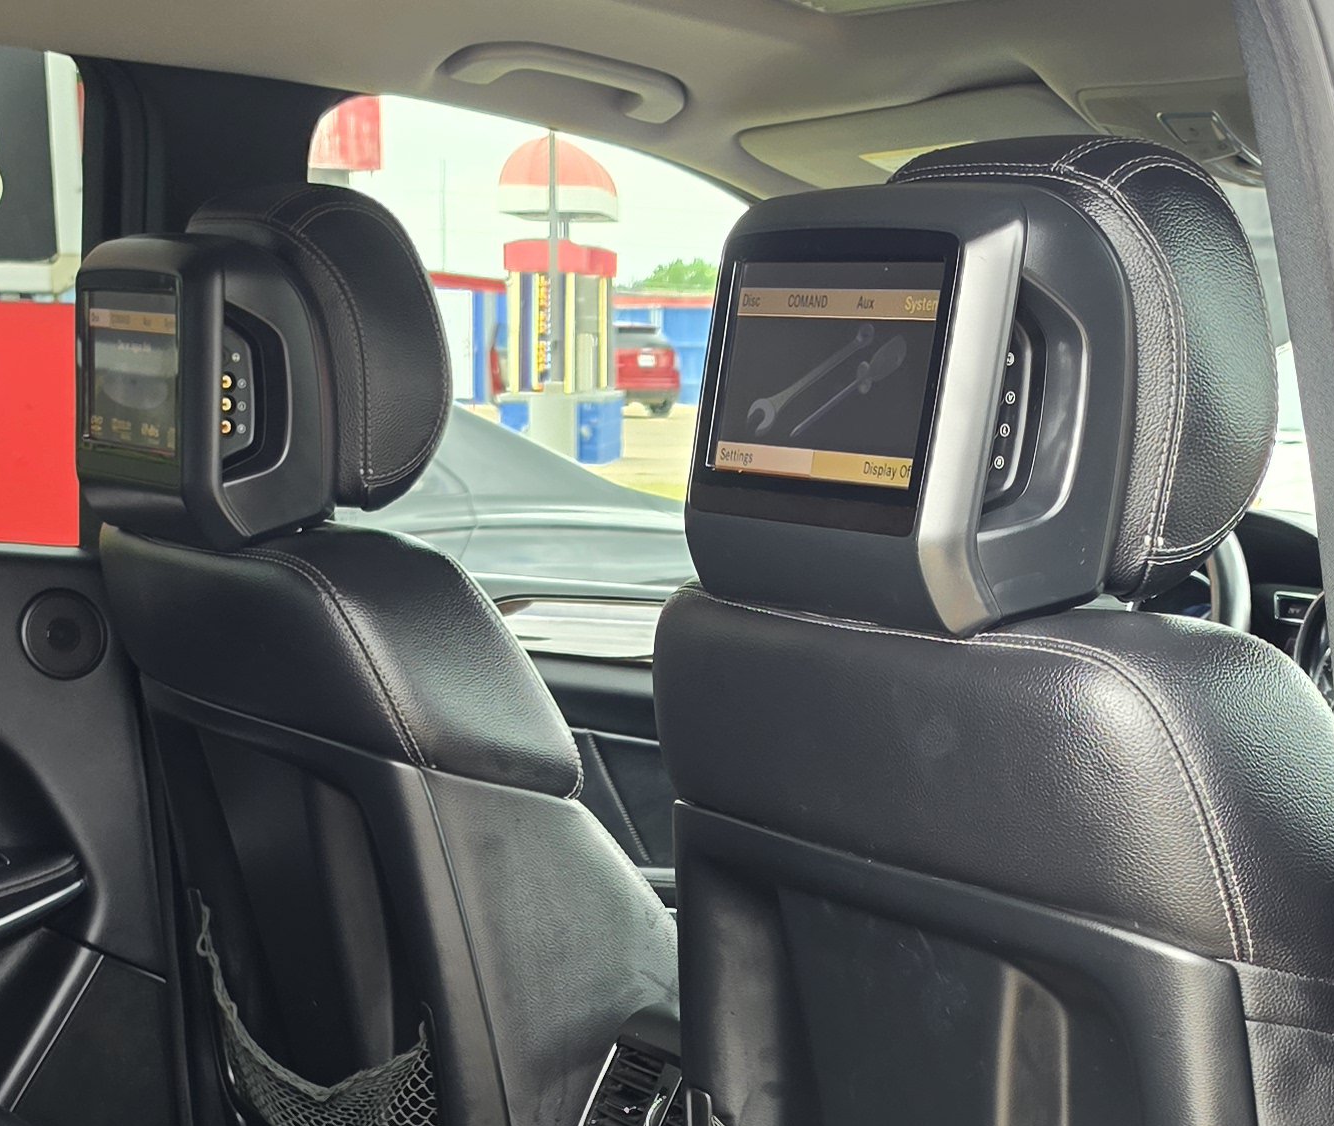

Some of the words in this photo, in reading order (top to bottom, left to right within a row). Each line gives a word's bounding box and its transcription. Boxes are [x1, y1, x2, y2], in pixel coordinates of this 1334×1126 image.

[742, 293, 761, 308] Disc
[787, 294, 828, 309] COMAND
[856, 295, 875, 310] Aux
[720, 449, 753, 466] Settings
[863, 461, 897, 481] Display
